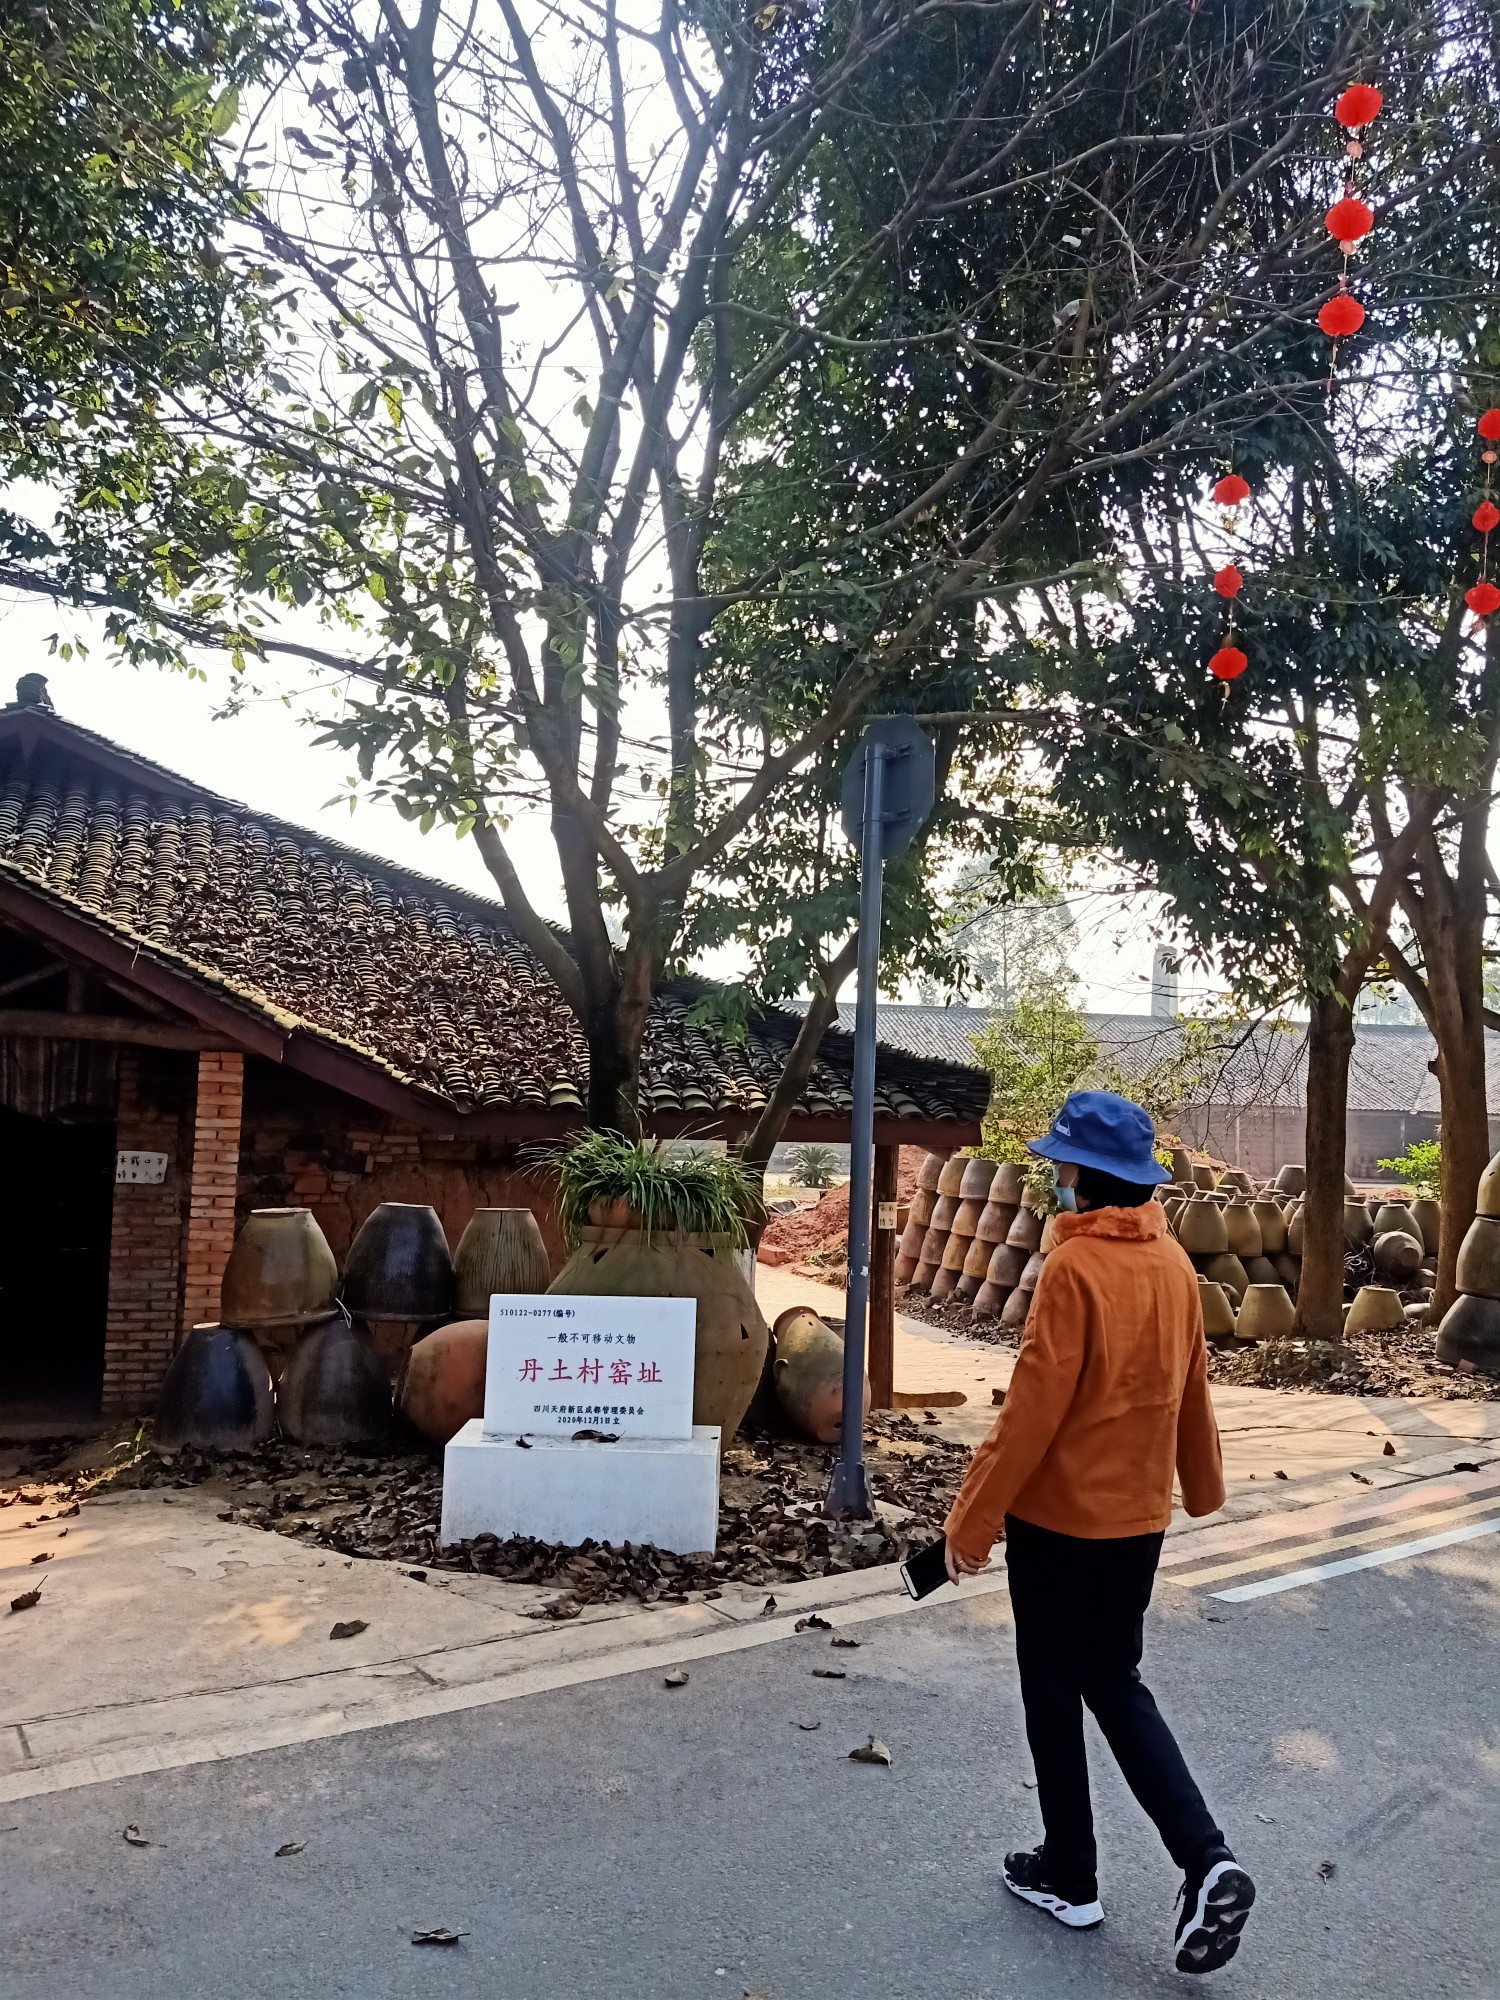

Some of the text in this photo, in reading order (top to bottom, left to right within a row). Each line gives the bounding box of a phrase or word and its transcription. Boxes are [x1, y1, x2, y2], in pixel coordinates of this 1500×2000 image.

[546, 1331, 636, 1345] 一般不可移动文物
[518, 1358, 663, 1386] 丹土村窑址
